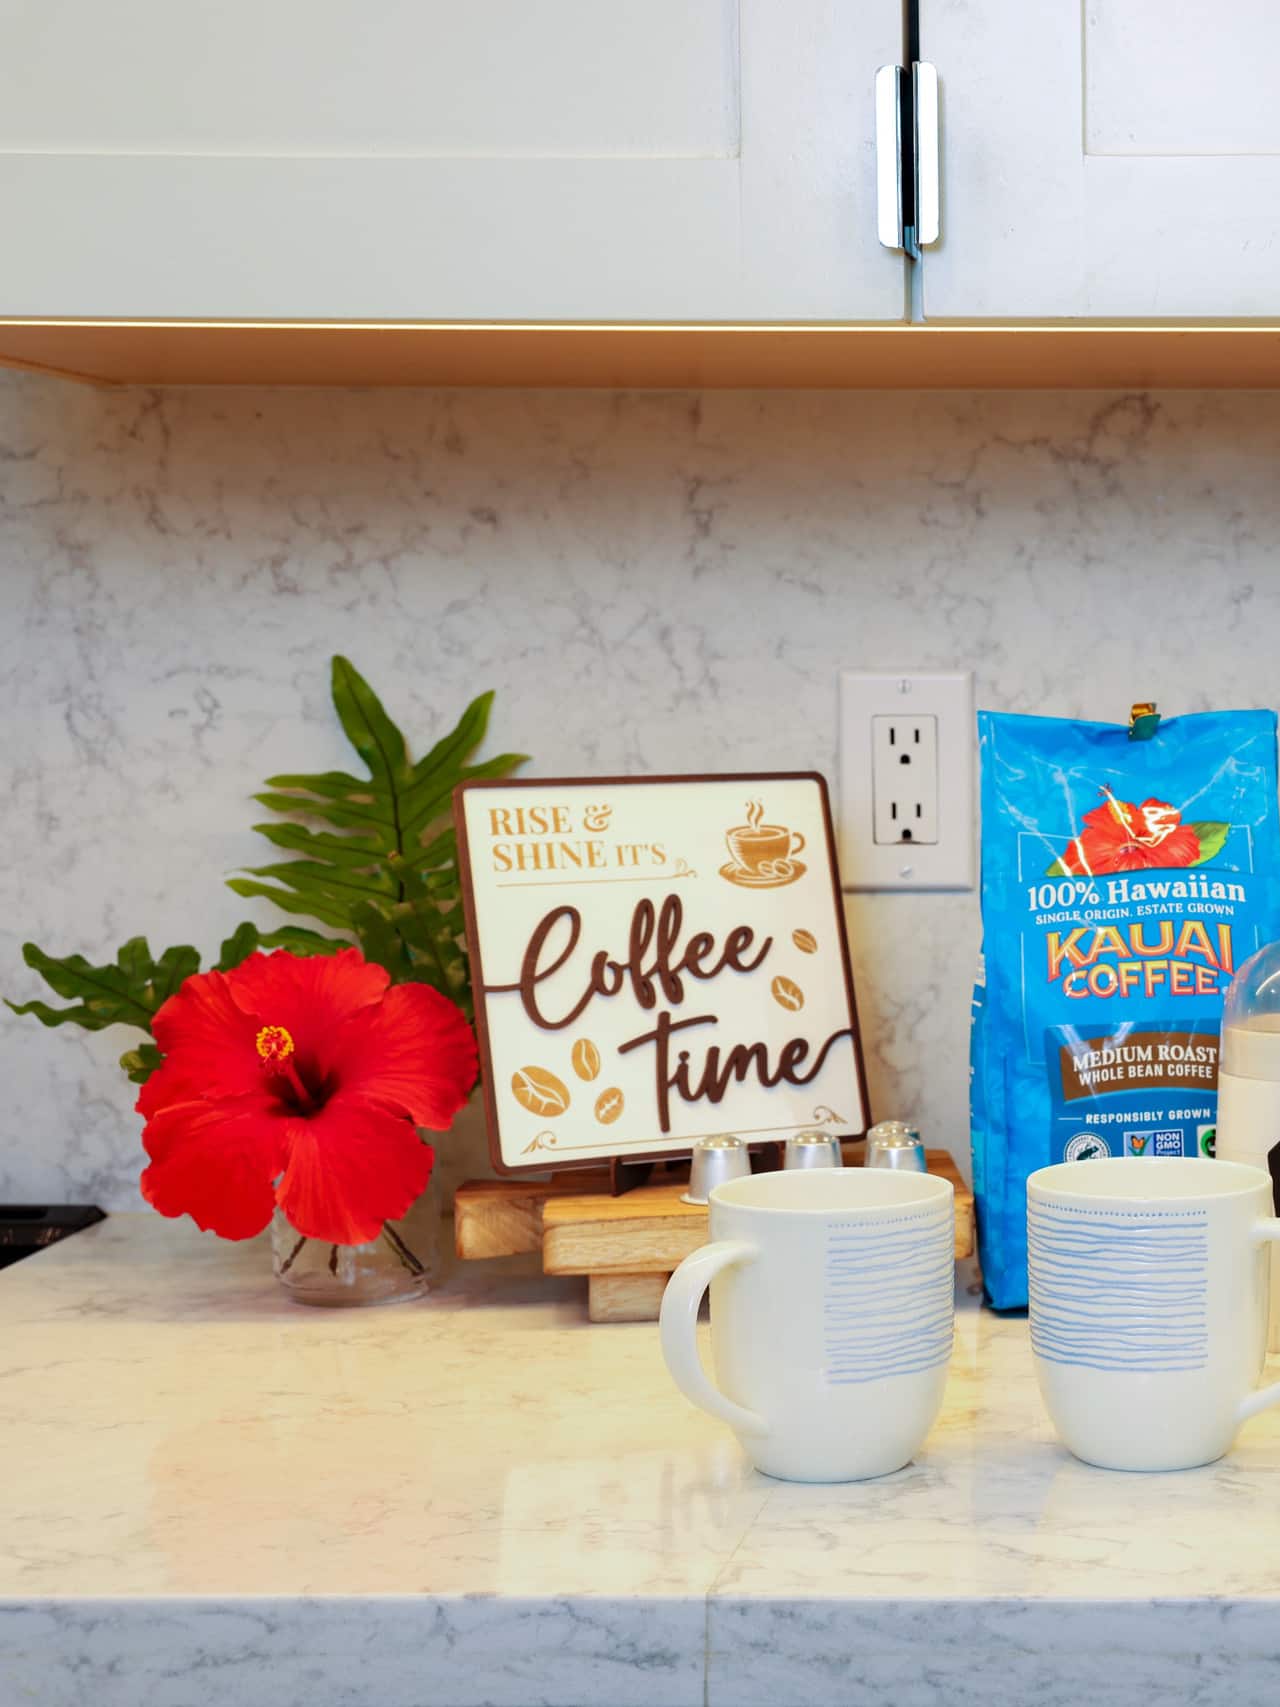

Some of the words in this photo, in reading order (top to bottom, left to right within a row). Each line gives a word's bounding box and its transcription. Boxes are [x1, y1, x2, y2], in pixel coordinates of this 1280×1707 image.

[488, 806, 573, 836] RISE
[583, 803, 613, 833] &
[493, 839, 608, 872] SHINE
[616, 842, 667, 867] IT'S
[1028, 882, 1100, 912] 100%
[1107, 874, 1246, 904] Hawaiian
[1035, 910, 1081, 925] SINGLE
[1136, 903, 1184, 916] ESTATE
[1187, 902, 1235, 915] GROWN
[519, 893, 774, 1031] Coffee
[1045, 920, 1235, 983] KAUAI
[1062, 959, 1219, 999] COFFEE
[1073, 1045, 1152, 1072] MEDIUM
[1157, 1044, 1217, 1063] ROAST
[1079, 1066, 1125, 1087] WHOLE
[1128, 1064, 1163, 1078] BEAN
[1167, 1063, 1213, 1079] COFFEE
[1086, 1111, 1164, 1124] RESPONSIBLY
[1168, 1108, 1211, 1120] GROWN
[1156, 1132, 1180, 1141] NON
[1156, 1140, 1181, 1150] GMO
